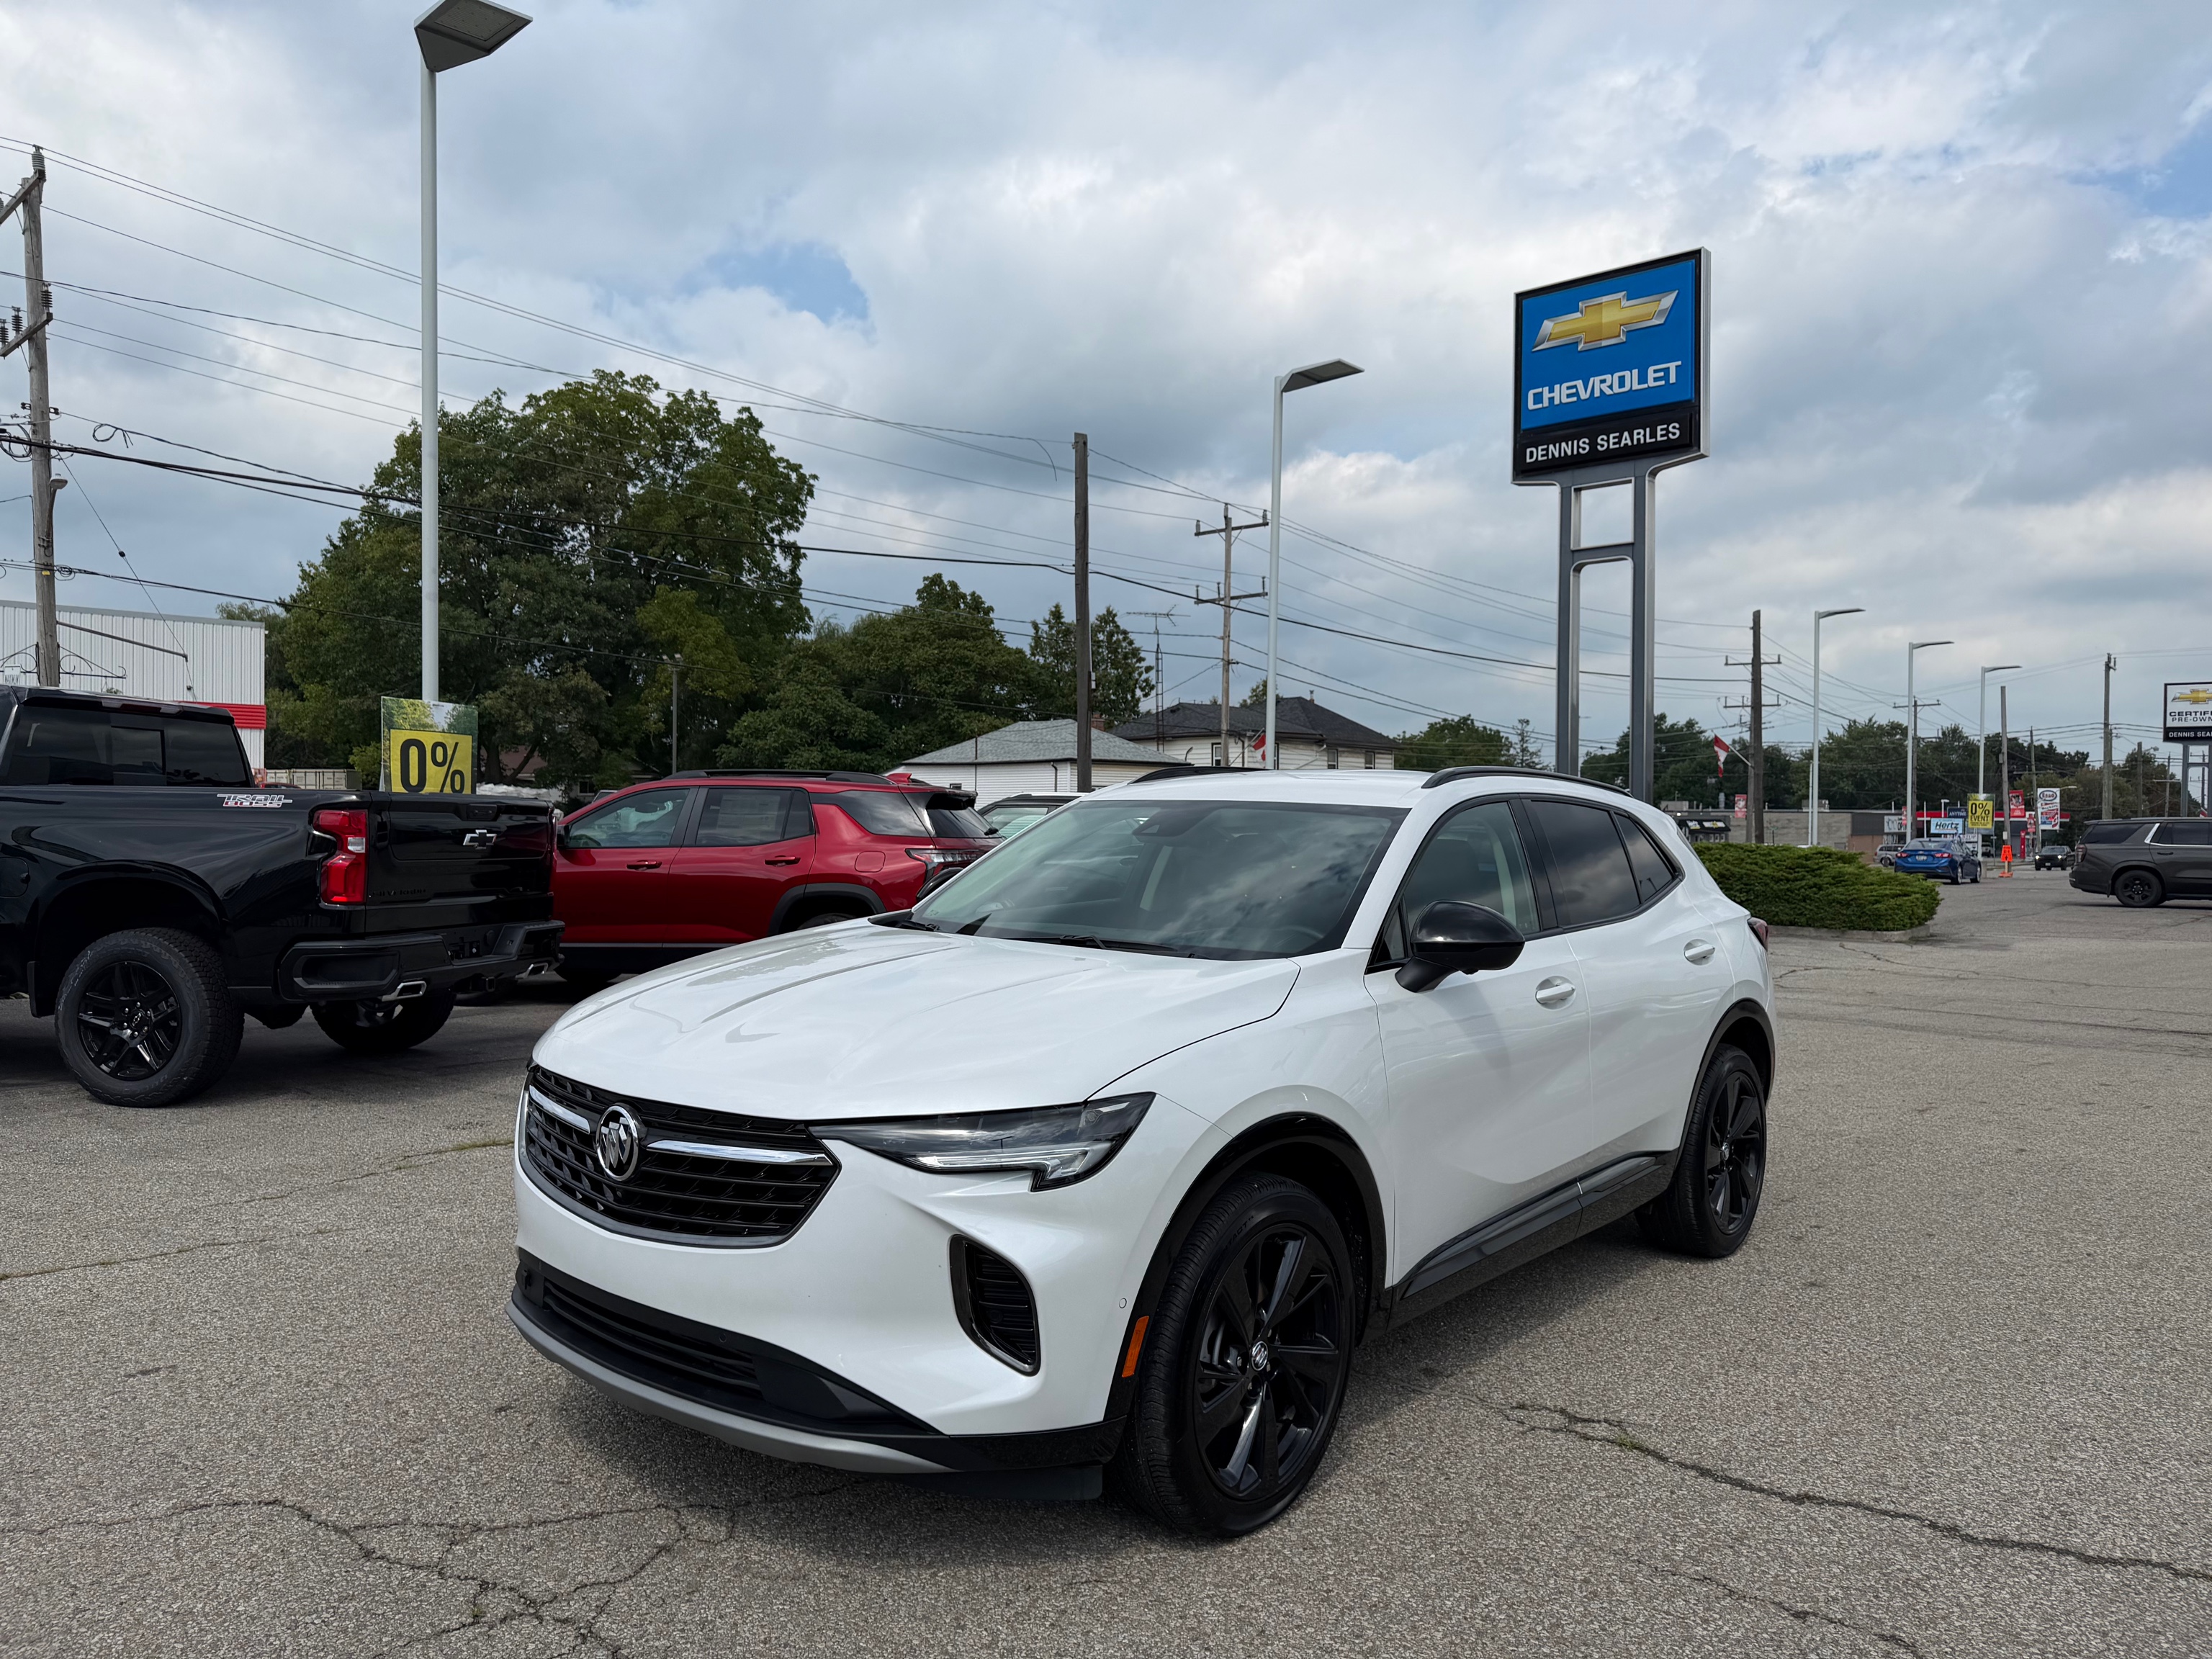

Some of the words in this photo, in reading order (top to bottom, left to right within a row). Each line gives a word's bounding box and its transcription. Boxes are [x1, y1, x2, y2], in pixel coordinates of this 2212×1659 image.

[1527, 361, 1682, 410] CHEVROLET
[1526, 438, 1590, 463] DENNIS
[1596, 422, 1680, 452] SEARLES
[400, 738, 465, 793] 0%
[217, 793, 292, 803] TRAIL
[1970, 802, 1990, 816] 0%
